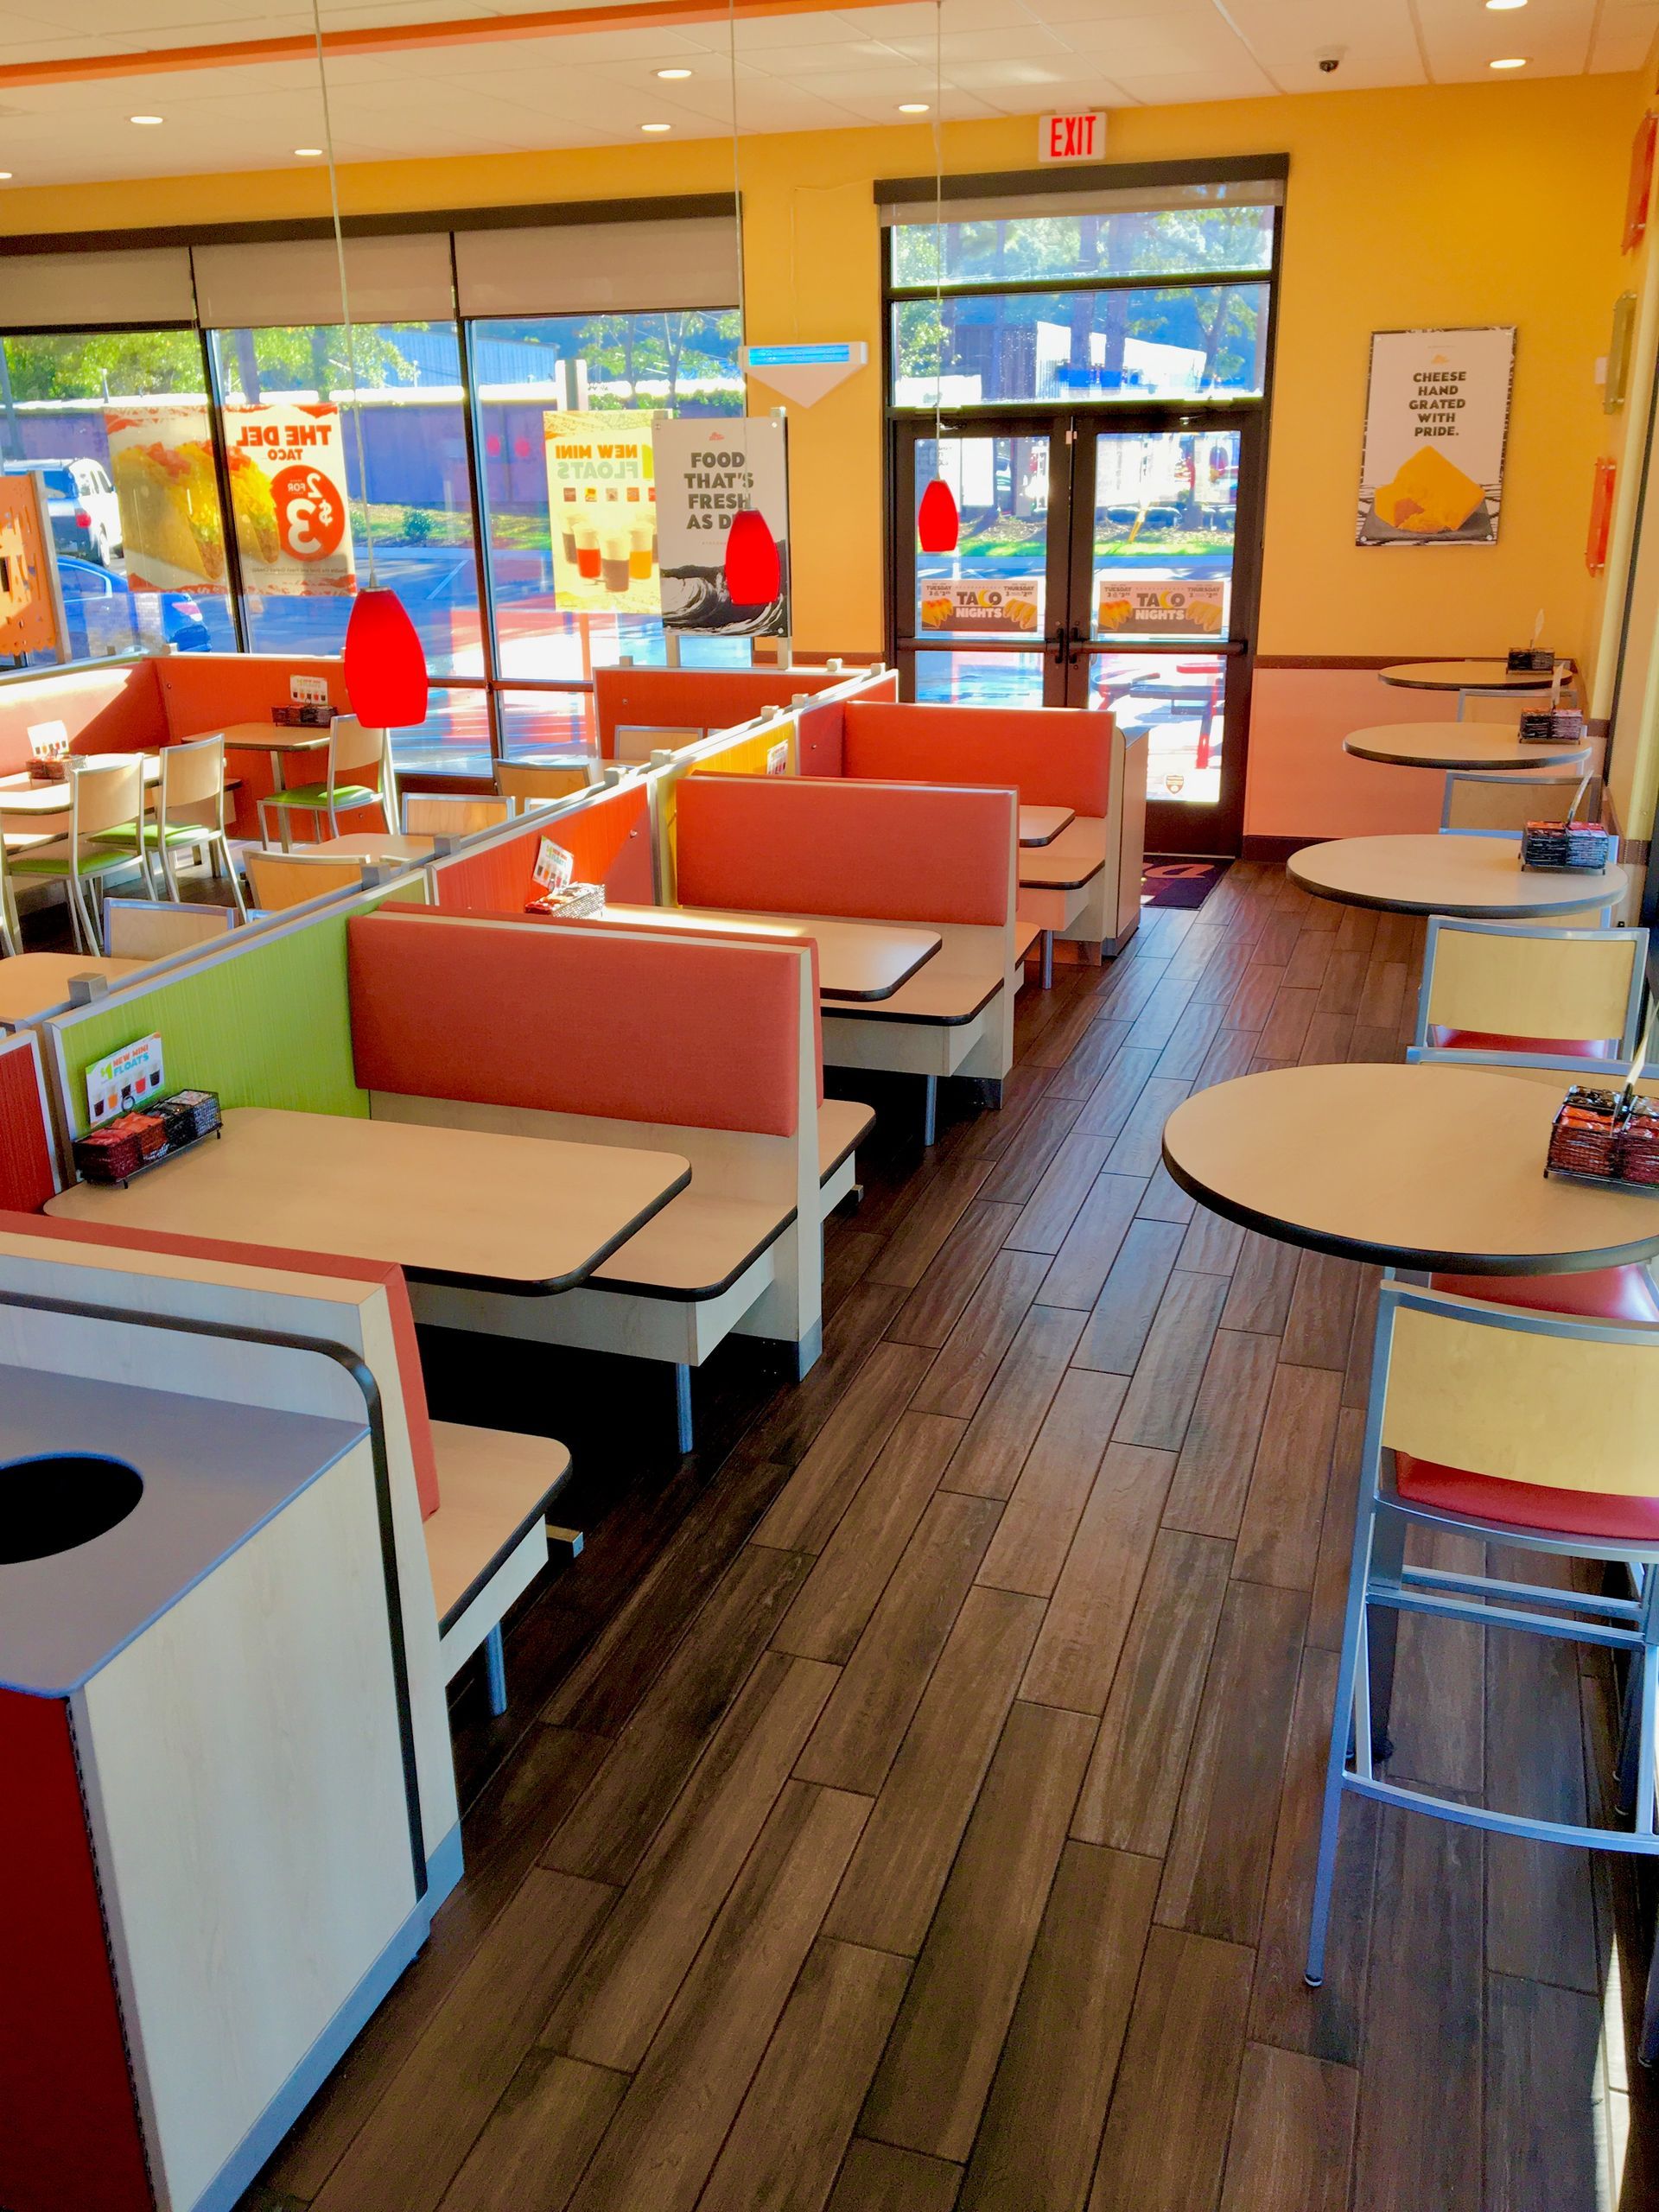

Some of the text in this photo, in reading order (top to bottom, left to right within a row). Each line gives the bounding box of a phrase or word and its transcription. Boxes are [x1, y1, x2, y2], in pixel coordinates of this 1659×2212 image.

[1051, 116, 1096, 157] EXIT
[1413, 372, 1466, 383] CHEESE
[1418, 385, 1459, 396] HAND
[1408, 398, 1466, 410] GRATED
[1417, 412, 1456, 423] WITH
[1414, 426, 1459, 436] PRIDE.
[691, 452, 745, 468] FOOD
[683, 473, 754, 489] THAT'S
[686, 513, 713, 530] AS
[957, 589, 1002, 607] TACO
[1136, 591, 1185, 609] TACO
[956, 607, 1002, 619] NIGHTS
[1135, 609, 1185, 620] NIGHTS
[113, 1053, 130, 1067] NEW
[132, 1044, 149, 1057] MINI
[114, 1052, 149, 1077] FLOATS
